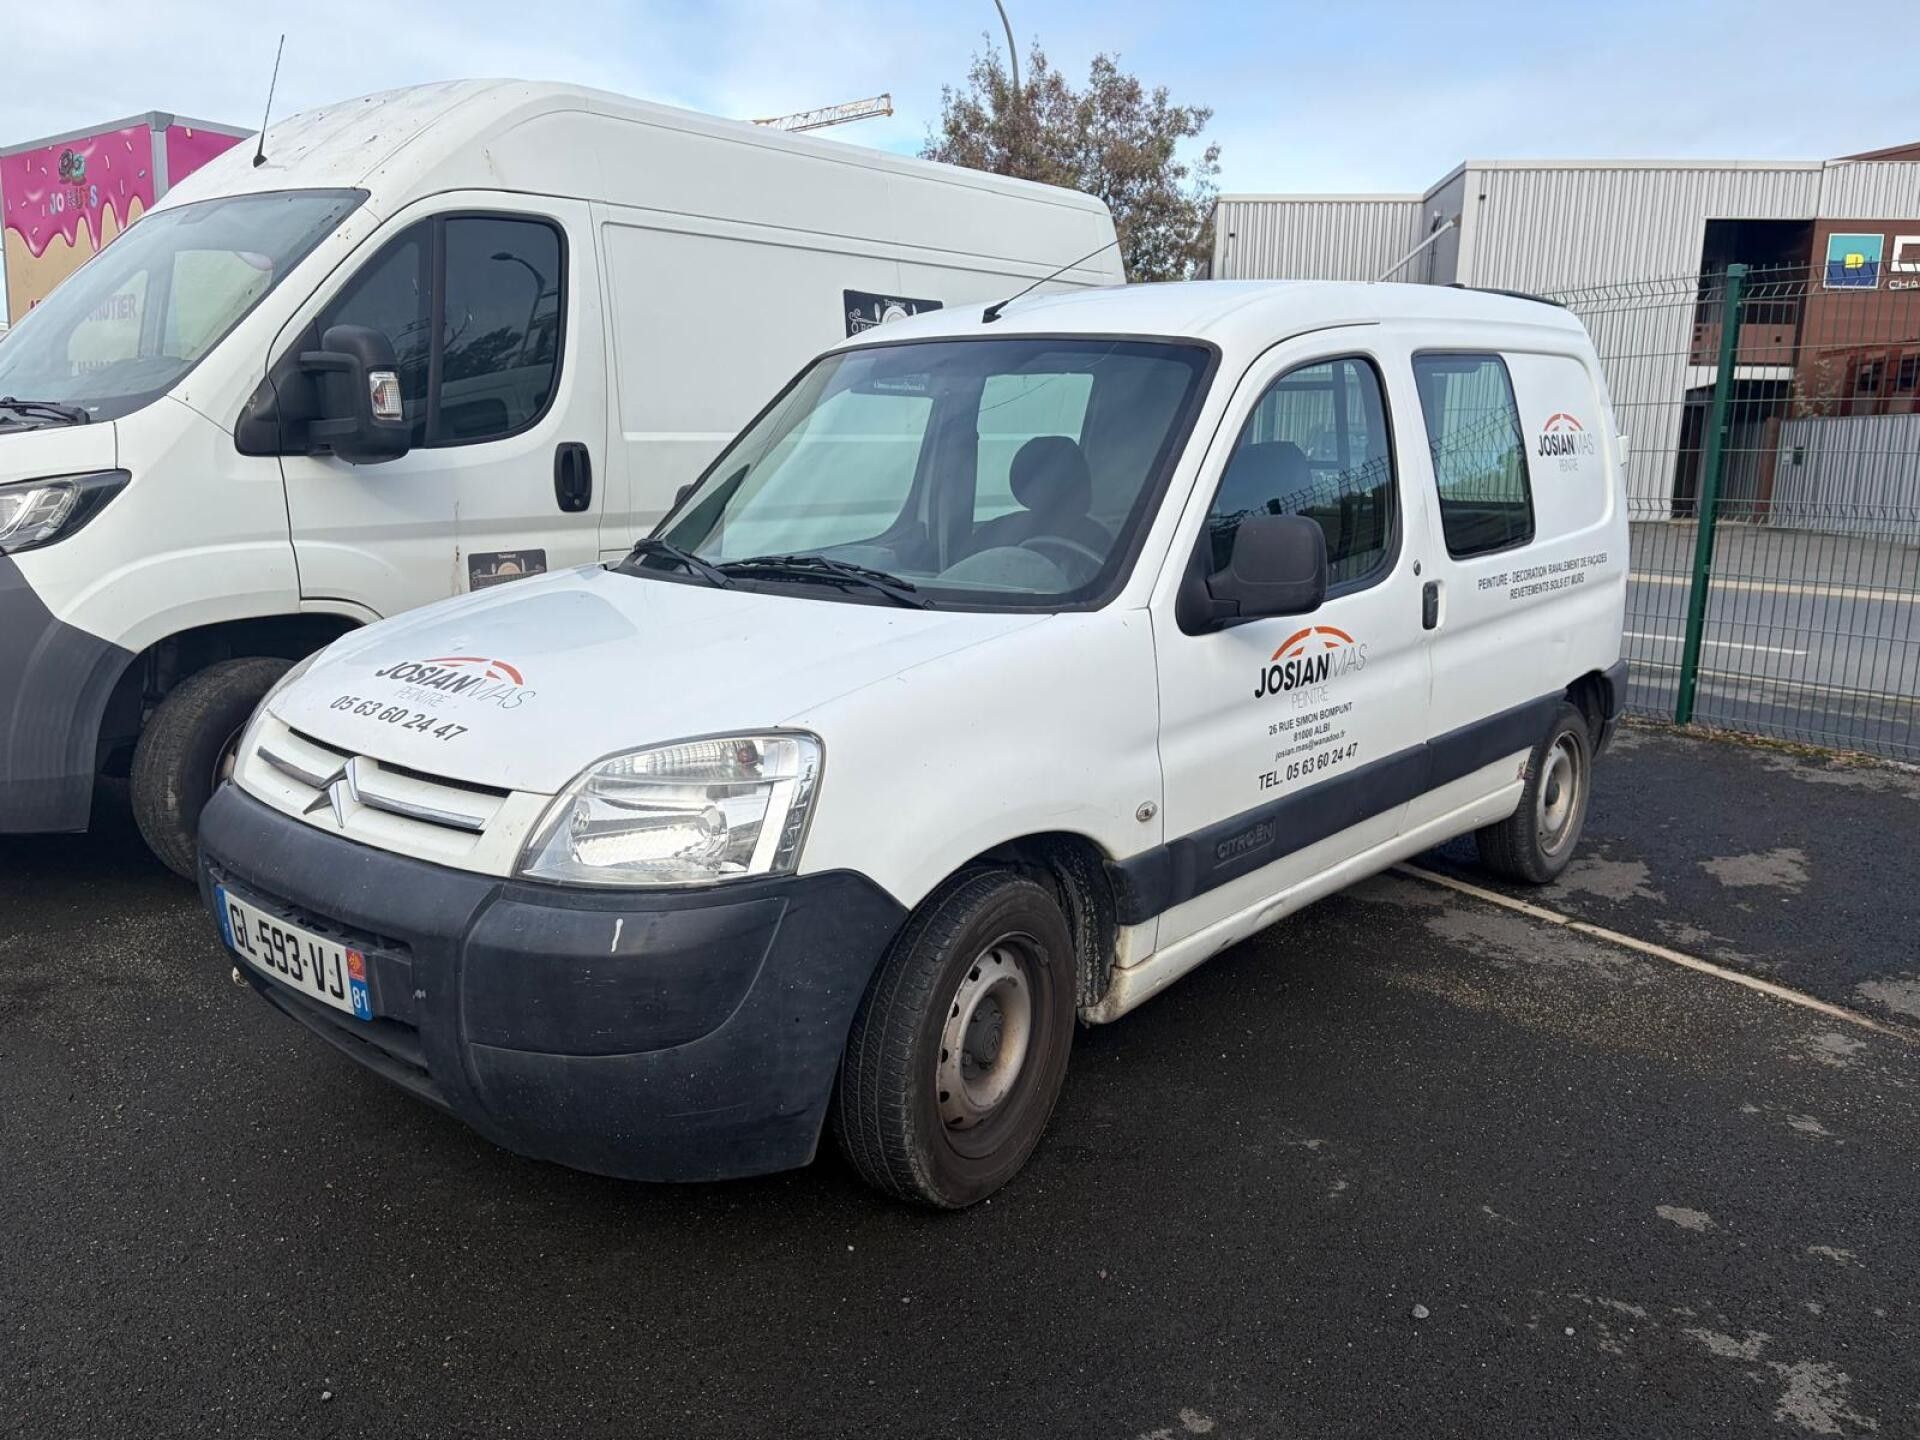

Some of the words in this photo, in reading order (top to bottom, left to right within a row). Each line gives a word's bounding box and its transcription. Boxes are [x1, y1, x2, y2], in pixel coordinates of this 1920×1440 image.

[1478, 573, 1508, 590] PEINTURE
[1580, 557, 1586, 569] DE
[1550, 577, 1563, 591] SOLS
[1563, 575, 1570, 588] ET
[1571, 572, 1585, 585] MURS
[329, 695, 361, 711] 05
[353, 701, 384, 717] 63
[377, 706, 409, 724] 60
[401, 713, 438, 733] 24
[433, 723, 468, 741] 47
[1268, 724, 1278, 736] 26
[1279, 719, 1295, 732] RUE
[1295, 711, 1319, 728] SIMON
[1293, 727, 1313, 742] 81000
[1314, 721, 1331, 736] ALBI
[1258, 770, 1283, 790] TEL.
[1287, 762, 1299, 781] 05
[1302, 757, 1315, 775] 63
[1317, 752, 1329, 770] 60
[1331, 747, 1344, 764] 24
[1346, 742, 1358, 759] 47
[229, 903, 345, 1000] GL-593-VJ
[352, 986, 369, 1012] 81
